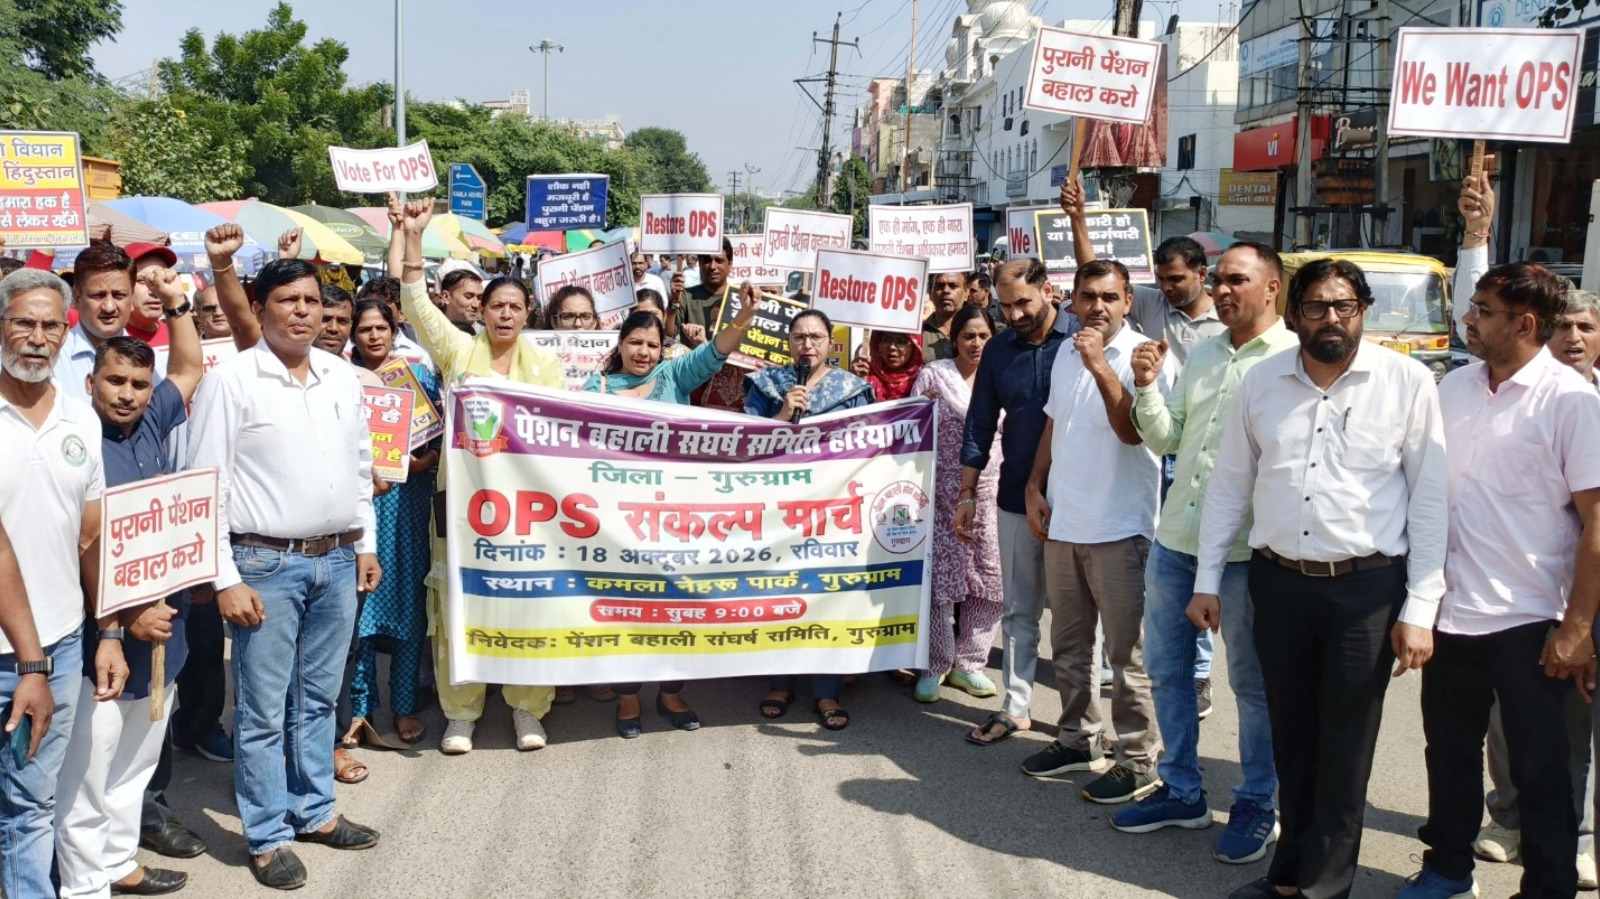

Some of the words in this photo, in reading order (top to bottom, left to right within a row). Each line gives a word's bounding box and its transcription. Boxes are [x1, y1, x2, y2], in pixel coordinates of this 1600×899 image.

[1042, 46, 1096, 74] पुरानी
[1100, 50, 1150, 77] पेंशन
[1041, 79, 1096, 102] बहाल
[1099, 85, 1139, 108] करो
[1401, 61, 1436, 105] We
[1445, 62, 1508, 108] Want
[1516, 60, 1571, 111] OPS
[12, 138, 63, 157] विधान
[4, 161, 75, 185] हिंदुस्तान
[337, 159, 371, 182] Vote
[373, 160, 396, 181] For
[399, 153, 429, 181] OPS
[35, 195, 57, 210] हक
[60, 191, 70, 208] है
[541, 203, 568, 216] पुरानी
[570, 203, 594, 212] पेंशन
[16, 211, 49, 227] लेकर
[645, 211, 685, 235] Restore
[688, 210, 717, 238] OPS
[879, 219, 891, 234] एक
[892, 217, 900, 234] ही
[922, 219, 936, 234] एक
[937, 215, 945, 233] ही
[947, 218, 962, 232] नारा
[1115, 214, 1131, 226] हो
[769, 224, 790, 257] पुरानी
[791, 224, 810, 253] पेंशन
[947, 241, 968, 256] हमारा
[1010, 228, 1030, 254] We
[1047, 232, 1063, 241] या
[592, 269, 614, 294] बहाल
[613, 257, 628, 287] करो
[819, 268, 876, 304] Restore
[880, 273, 919, 312] OPS
[535, 333, 561, 347] जो
[747, 328, 781, 348] पेंशन
[514, 405, 582, 449] पेंशन
[588, 421, 674, 455] बहाली
[678, 423, 744, 457] संघर्ष
[747, 426, 822, 457] समिति
[827, 419, 922, 454] हरियाणा
[588, 461, 664, 485] जिला
[708, 468, 812, 494] गुरुग्राम
[110, 498, 164, 558] पुरानी
[168, 493, 212, 527] पेंशन
[467, 489, 601, 539] OPS
[618, 491, 765, 543] संकल्प
[778, 481, 866, 536] मार्च
[114, 552, 169, 587] बहाल
[171, 532, 205, 569] करो
[474, 537, 546, 562] दिनांक
[576, 545, 607, 563] 18
[620, 548, 699, 572] अक्टूबर
[708, 547, 781, 565] 2026,
[790, 539, 860, 560] रविवार
[483, 576, 554, 592] स्थान
[585, 577, 667, 593] कमला
[674, 575, 738, 594] नेहरू
[746, 570, 809, 592] पार्क,
[818, 568, 902, 592] गुरुग्राम
[597, 605, 644, 618] समय
[666, 606, 707, 624] सुबह
[714, 604, 765, 619] 9:00
[771, 600, 803, 616] बजे
[467, 629, 557, 650] निवेदक:
[565, 630, 621, 649] पेंशन
[627, 629, 696, 647] बहाली
[704, 628, 760, 647] संघर्ष
[766, 624, 839, 642] समिति,
[846, 621, 916, 645] गुरुग्राम
